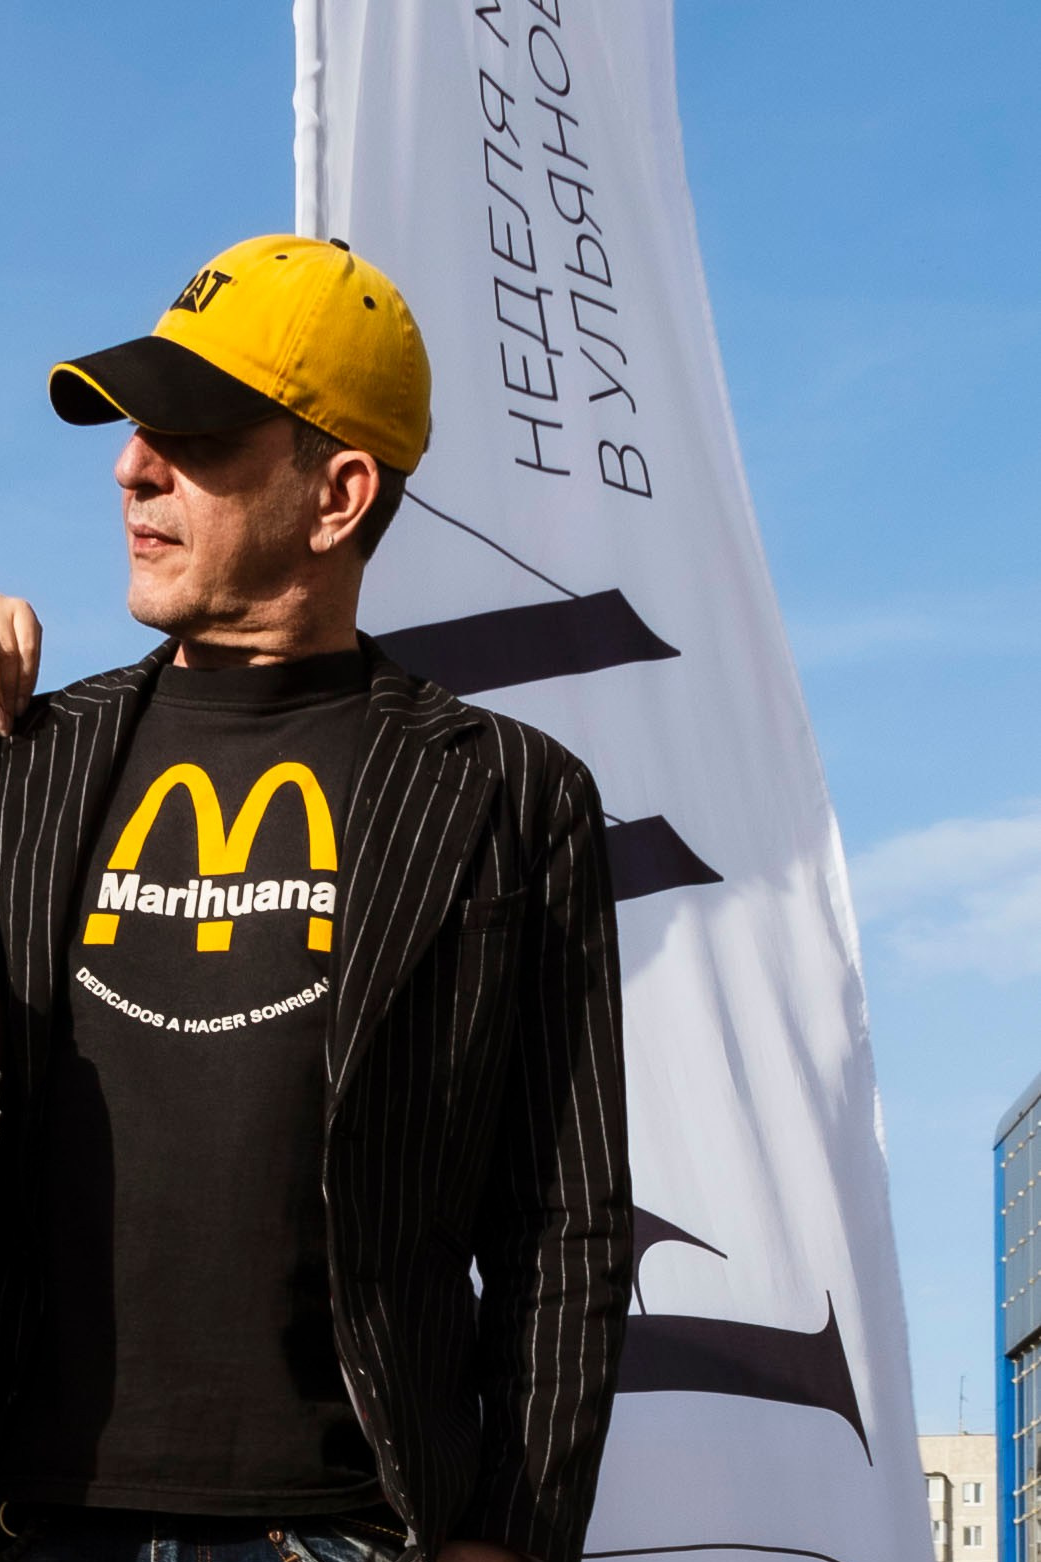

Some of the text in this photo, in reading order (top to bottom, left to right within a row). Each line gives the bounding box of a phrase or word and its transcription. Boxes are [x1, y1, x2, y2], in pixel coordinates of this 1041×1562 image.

[478, 68, 570, 476] НЕДЕЛЯ
[598, 439, 652, 498] В
[97, 872, 337, 918] Marihuana
[75, 966, 165, 1028] DEDICADOS
[166, 1015, 181, 1032] A
[184, 1013, 247, 1033] HACER
